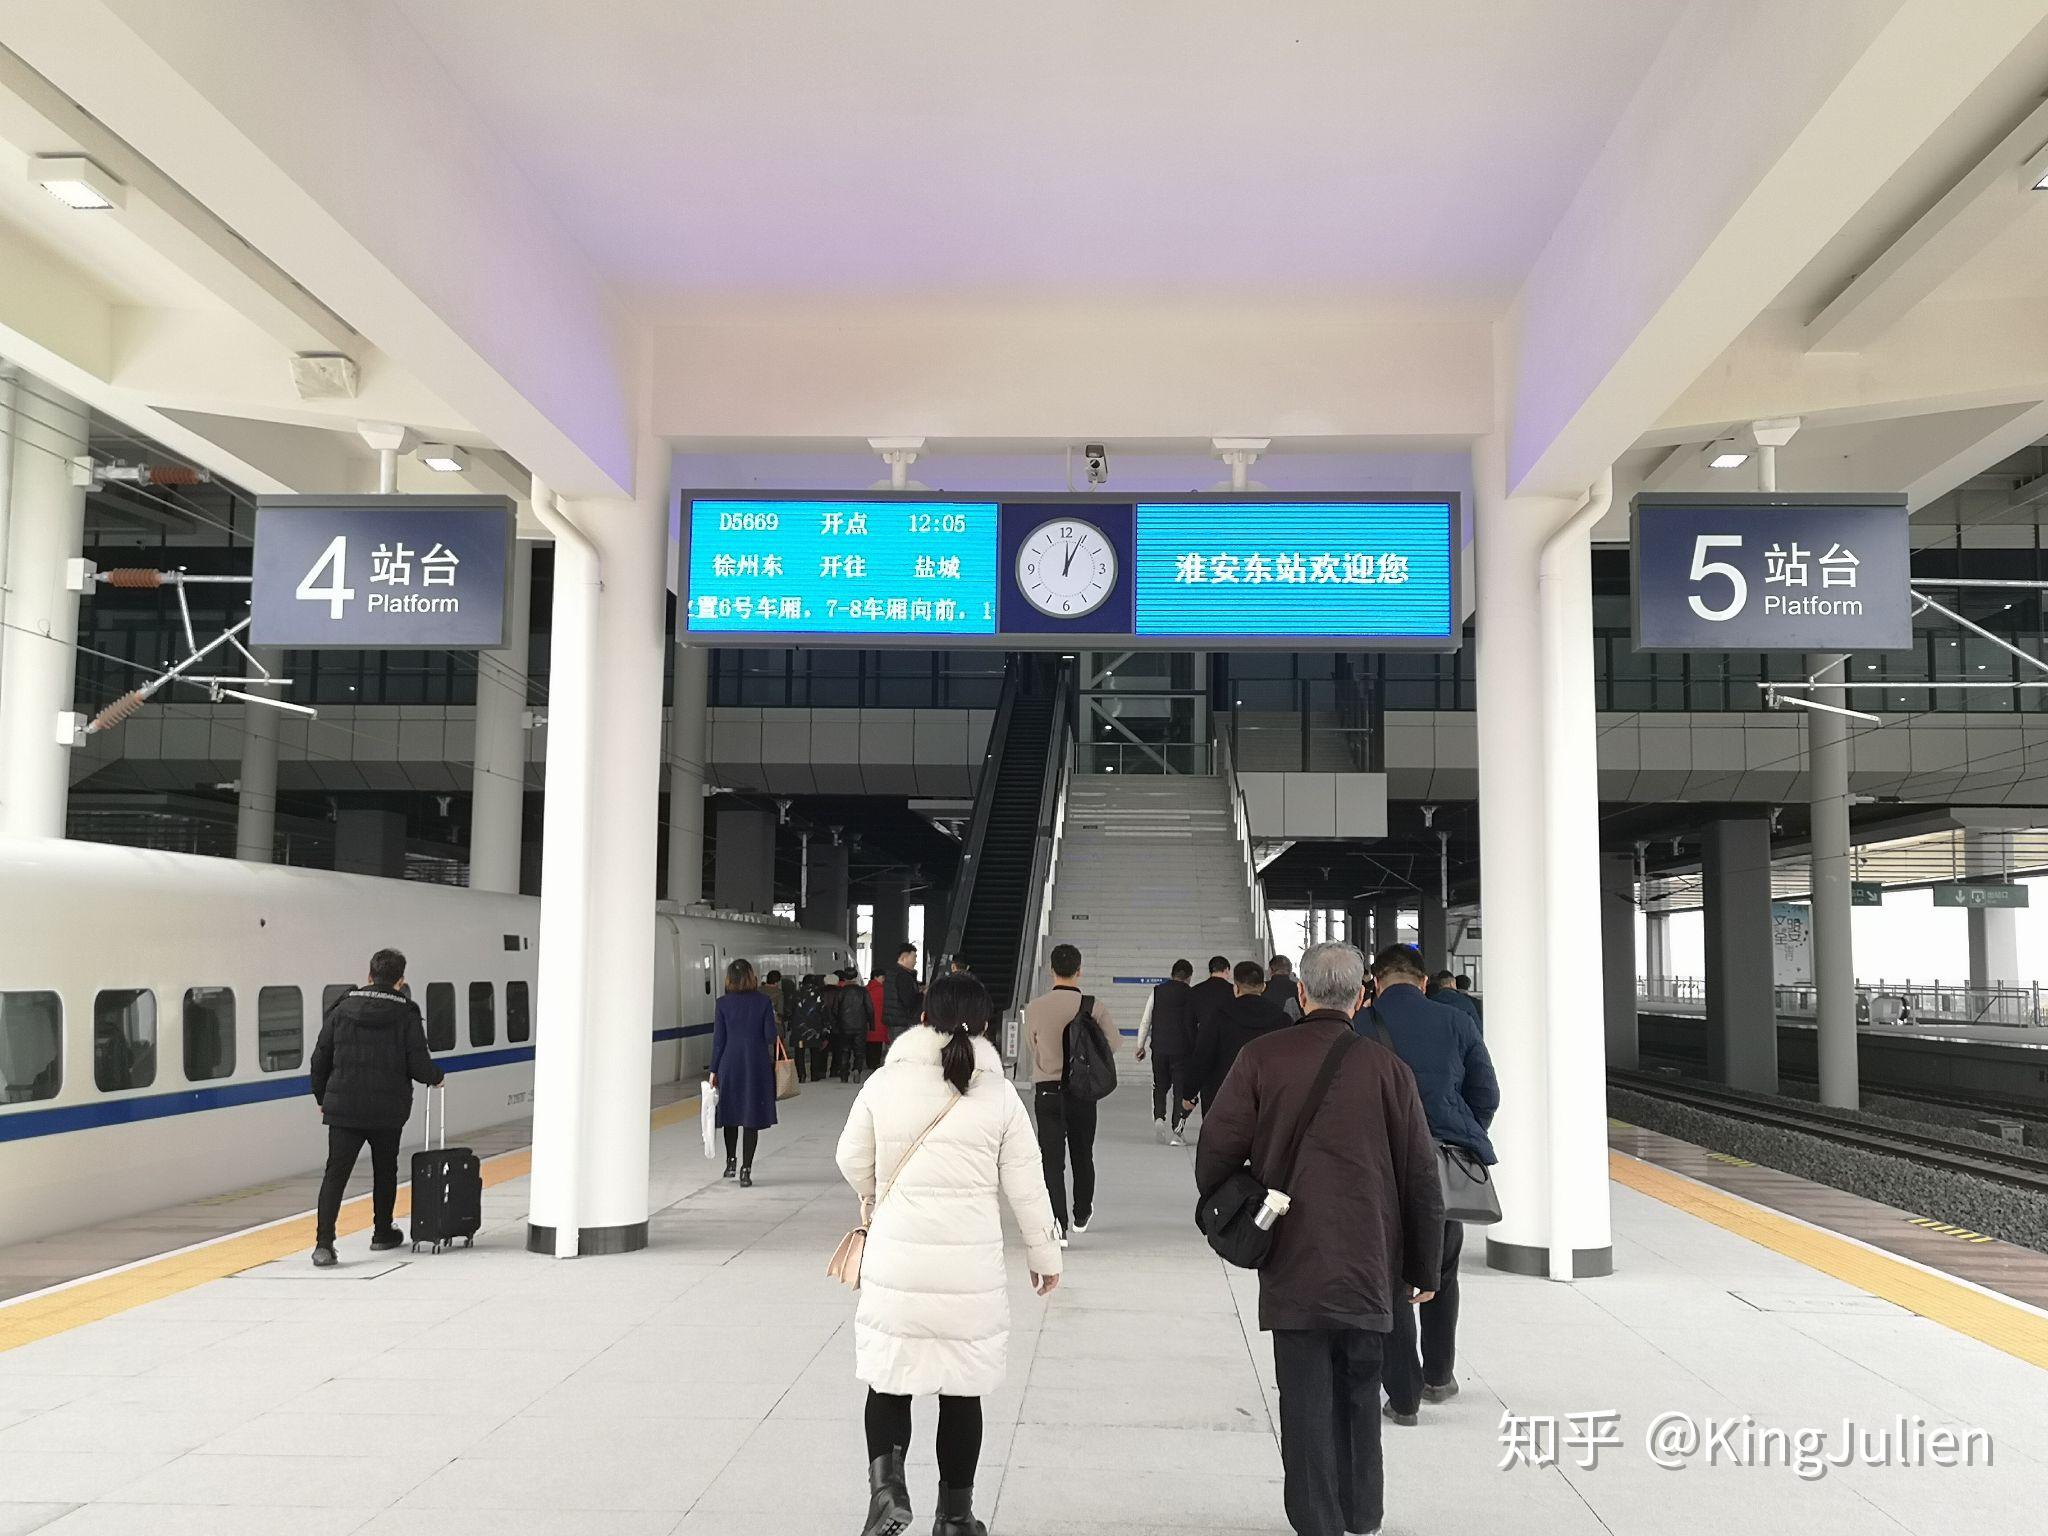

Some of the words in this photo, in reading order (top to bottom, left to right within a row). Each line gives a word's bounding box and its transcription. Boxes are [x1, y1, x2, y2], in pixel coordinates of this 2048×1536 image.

[719, 513, 779, 532] D5669
[820, 511, 869, 536] 开点
[908, 513, 967, 533] 12:05
[1060, 527, 1073, 539] 12
[712, 553, 784, 578] 徐州东
[819, 553, 868, 578] 开往
[913, 554, 962, 579] 盐城
[1027, 563, 1036, 575] 9
[1099, 563, 1106, 575] 3
[1174, 551, 1410, 584] 淮安东站欢迎您
[295, 535, 355, 620] 4
[369, 542, 460, 587] 站台
[1687, 534, 1748, 622] 5
[1764, 542, 1861, 589] 站台
[367, 593, 459, 613] Platform
[1062, 600, 1070, 612] 6
[1764, 595, 1863, 616] Platform
